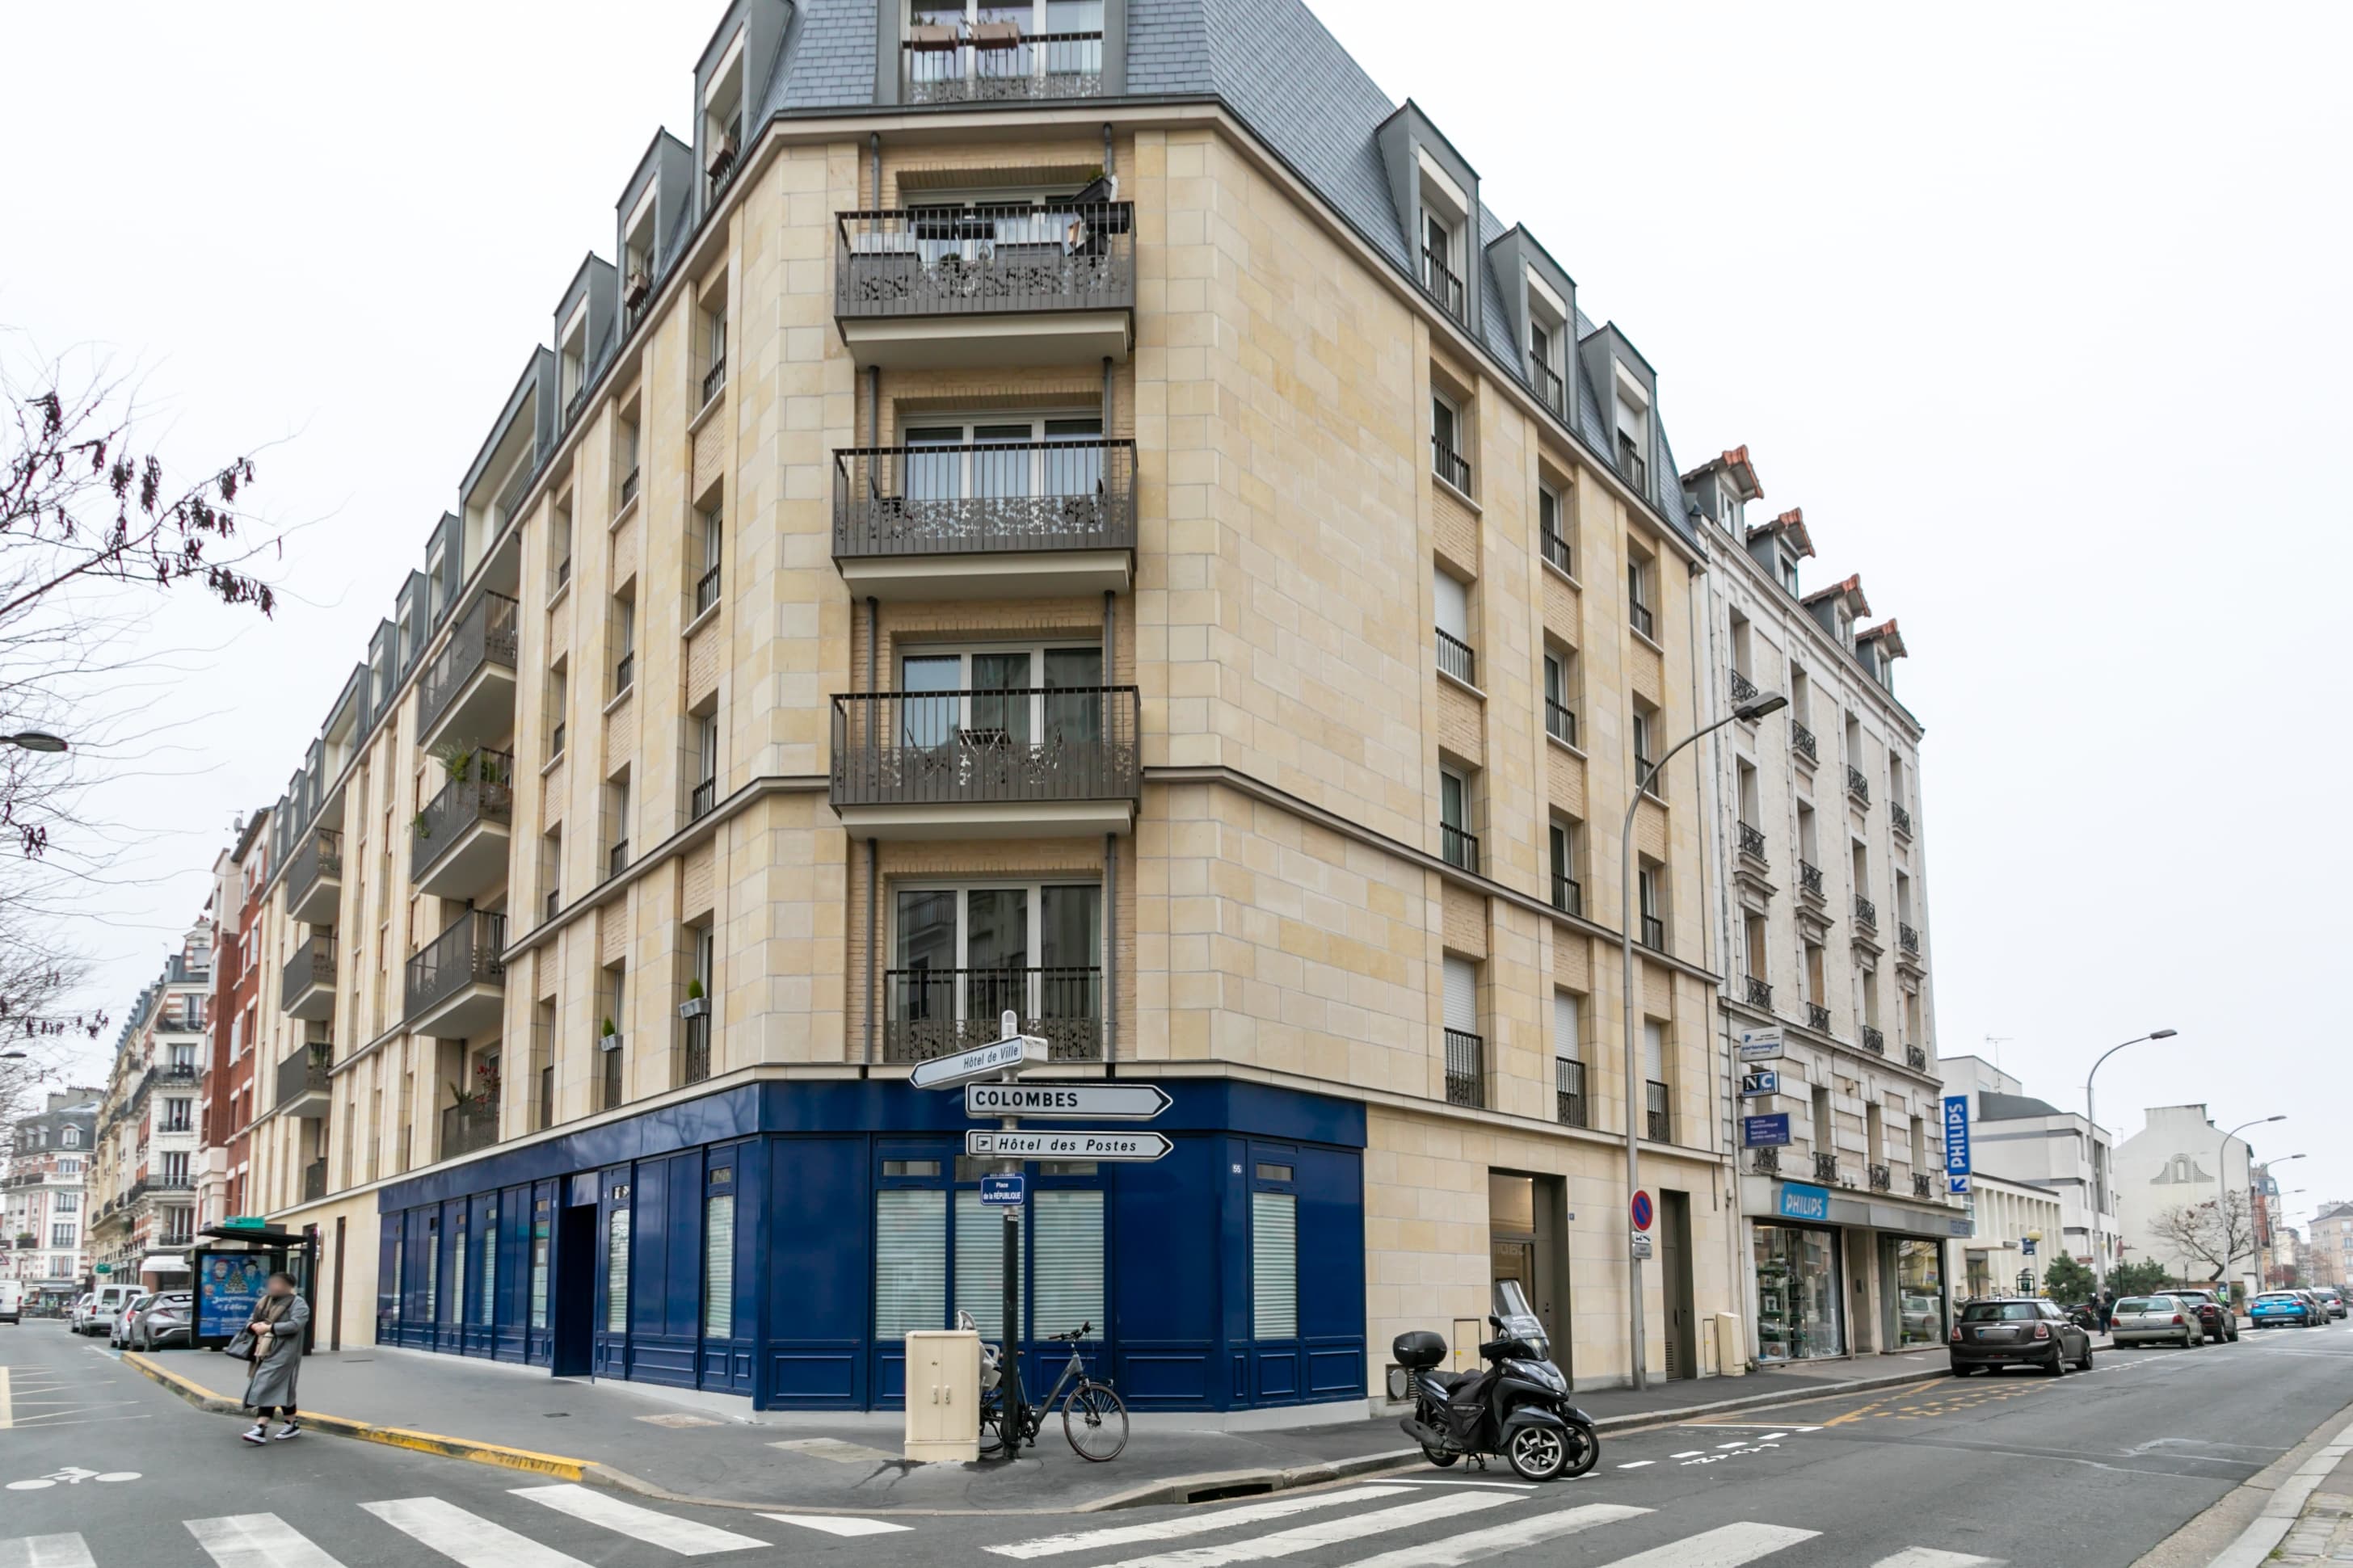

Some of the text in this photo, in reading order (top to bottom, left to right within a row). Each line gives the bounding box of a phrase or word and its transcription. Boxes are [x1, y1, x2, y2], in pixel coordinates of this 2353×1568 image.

[964, 1045, 1019, 1070] Hôtel de Ville
[975, 1091, 1078, 1108] COLOMBES
[999, 1137, 1137, 1152] Hôtel des Postes
[1948, 1103, 1965, 1168] PHILIPS
[994, 1191, 1021, 1200] RÉPUBLIQUE
[1786, 1193, 1823, 1217] PHILIPS
